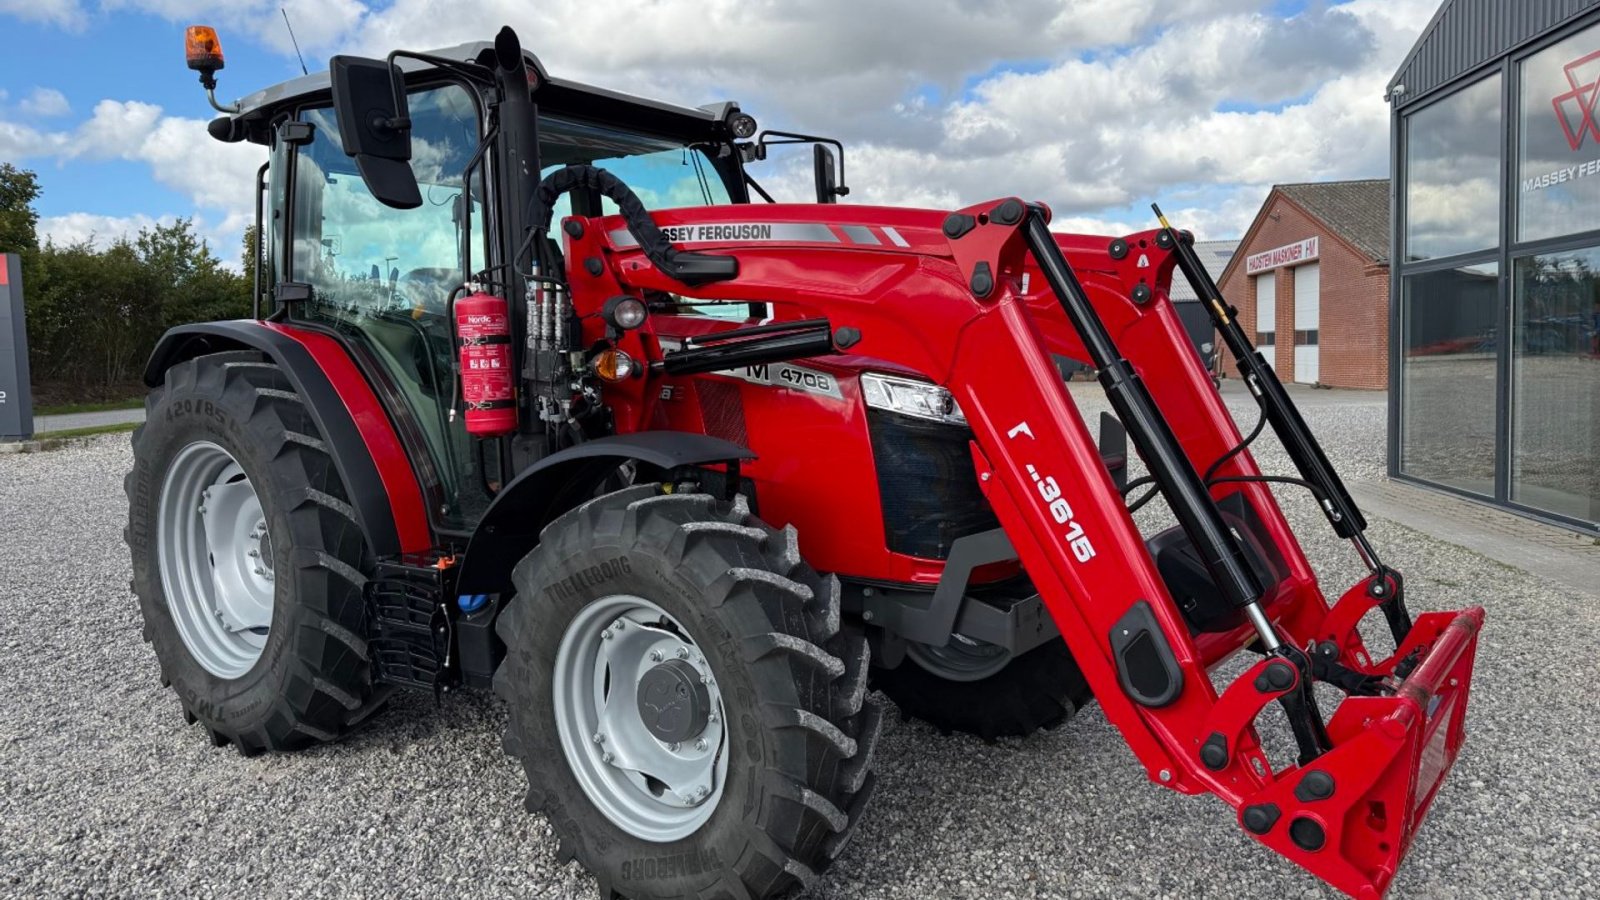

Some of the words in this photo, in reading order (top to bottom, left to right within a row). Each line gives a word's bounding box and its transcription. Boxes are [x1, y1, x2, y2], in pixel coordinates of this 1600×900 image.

[1523, 166, 1576, 193] MASSEY
[662, 226, 694, 241] SSEY
[699, 224, 771, 240] FERGUSON
[468, 314, 491, 324] Nordic
[780, 368, 830, 390] 4708
[543, 555, 632, 603] TRELLEBORG
